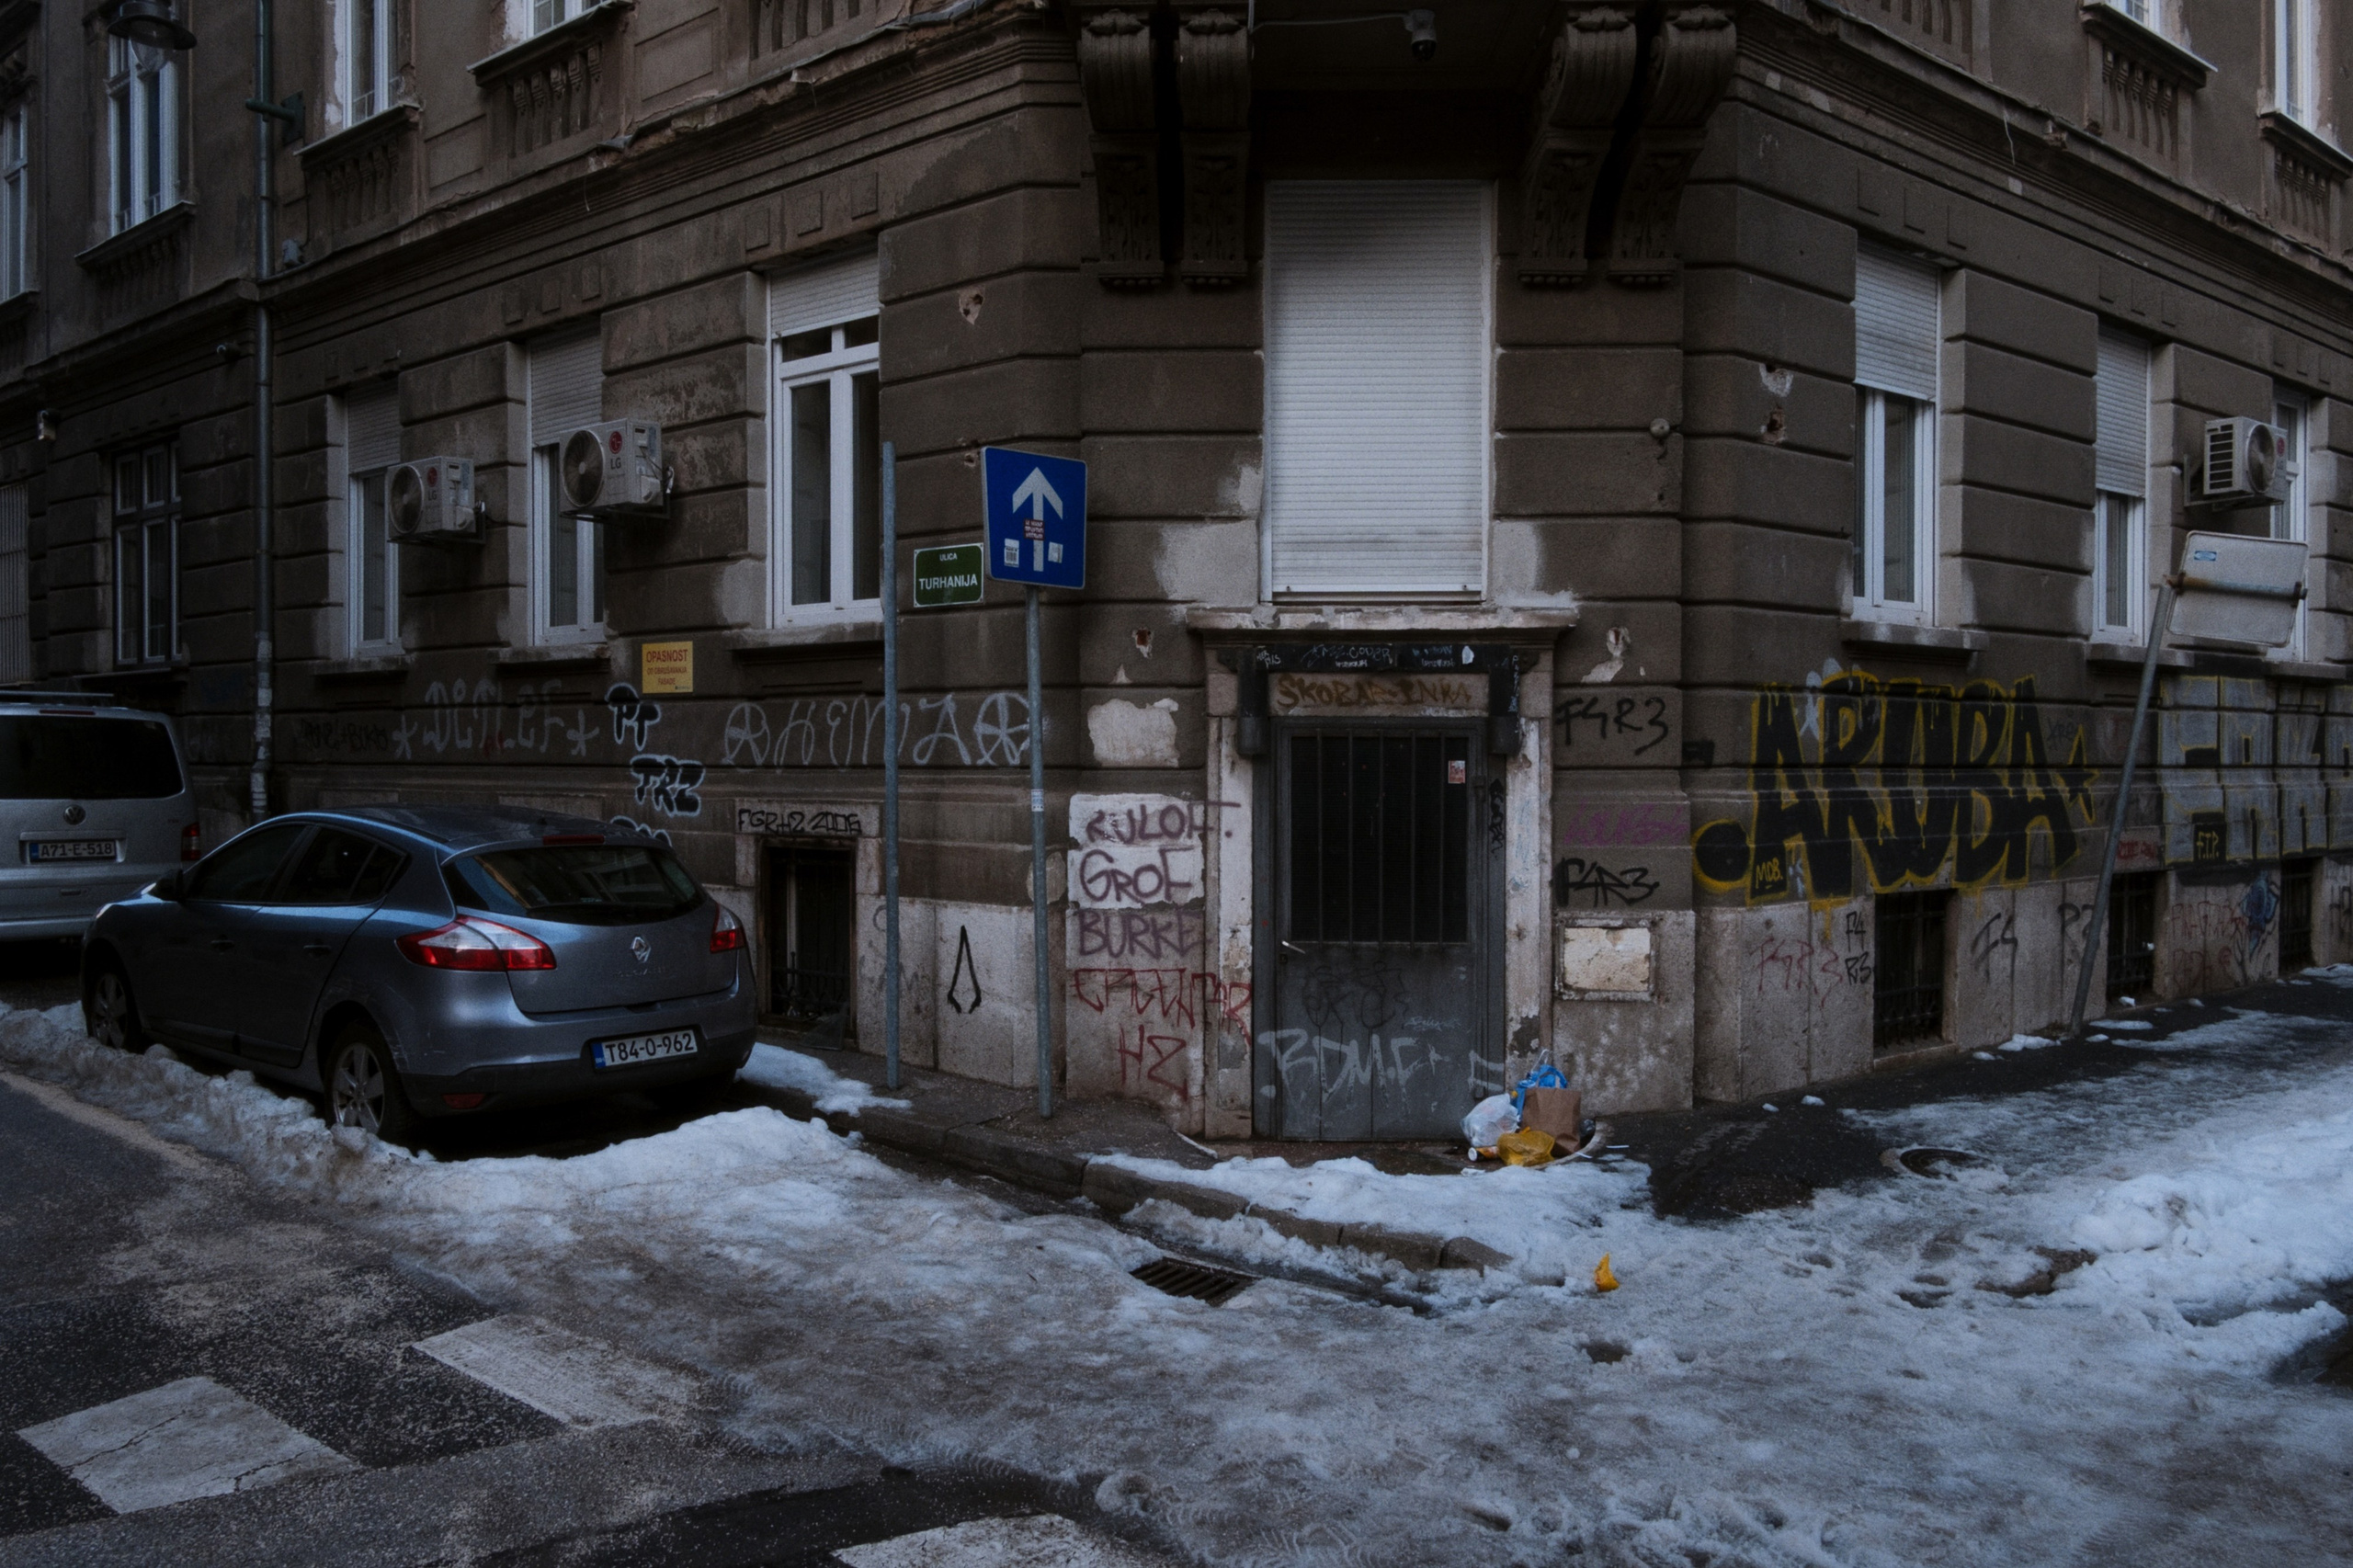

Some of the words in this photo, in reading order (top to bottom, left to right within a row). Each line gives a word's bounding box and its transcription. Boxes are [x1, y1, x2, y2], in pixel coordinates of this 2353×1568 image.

[610, 457, 621, 470] LG
[427, 490, 437, 501] LG
[939, 552, 958, 562] ULICA
[918, 573, 978, 590] TURHANIJA
[646, 649, 688, 663] OPASNOST
[40, 843, 113, 858] A71-E-518
[1077, 908, 1214, 960] BURKE
